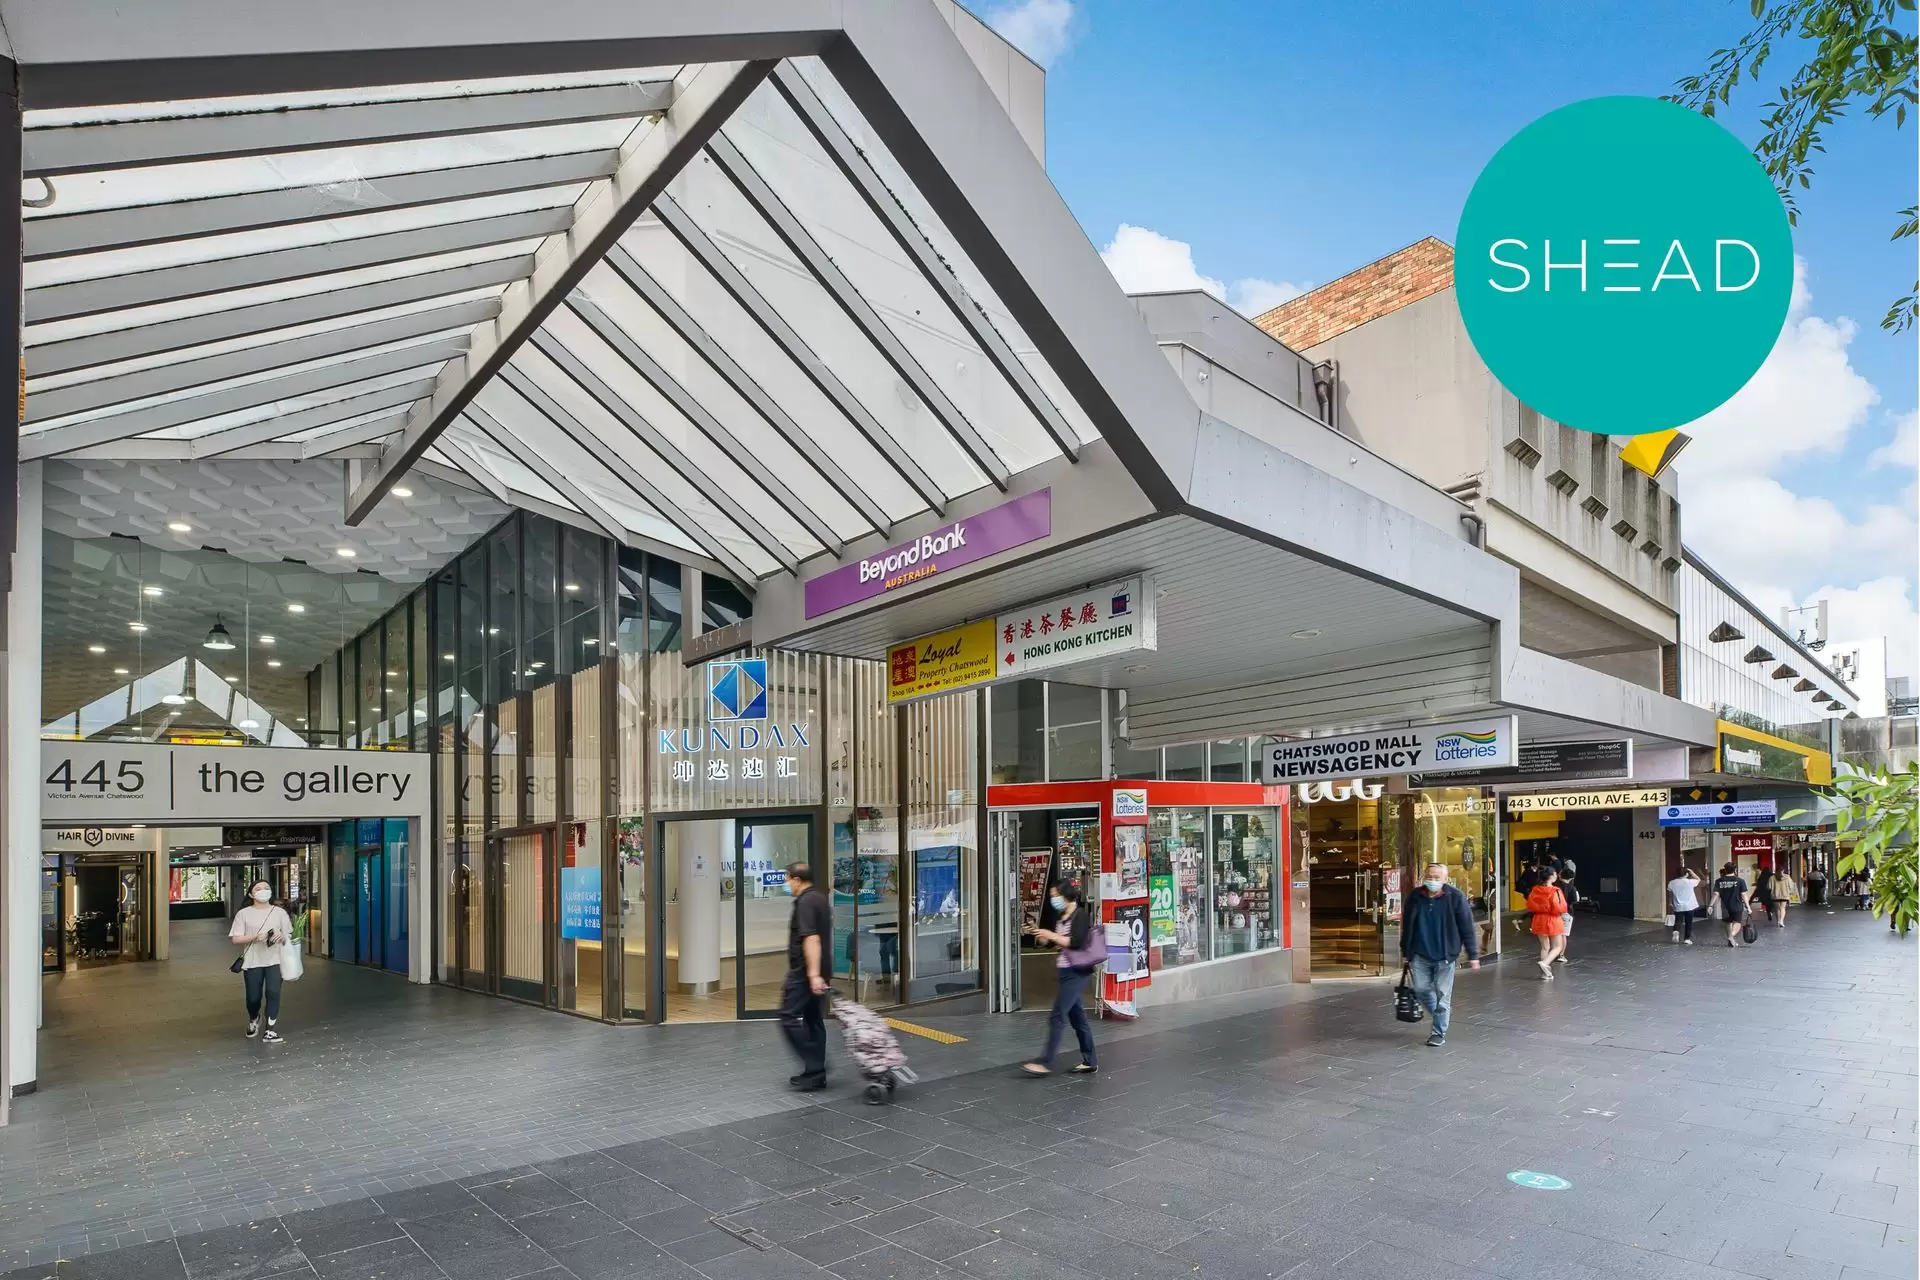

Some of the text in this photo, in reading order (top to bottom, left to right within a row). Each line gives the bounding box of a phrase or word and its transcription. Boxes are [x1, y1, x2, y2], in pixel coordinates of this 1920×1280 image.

[860, 523, 967, 584] Beyond Bank
[885, 563, 937, 588] AUSTRALIA
[1002, 601, 1098, 645] 香港茶餐廳
[919, 637, 963, 665] Loyal
[1023, 623, 1133, 660] HONG KONG KITCHEN
[918, 654, 989, 681] Property Chatswood
[953, 674, 963, 685] (02)
[964, 671, 977, 681] 9415
[892, 689, 905, 698] Shop
[659, 723, 811, 754] KUNDAX
[1272, 734, 1422, 761] CHATSWOOD MALL
[1437, 738, 1461, 749] NSW
[1272, 750, 1422, 778] NEWSAGENCY
[1435, 745, 1497, 763] Lotteries
[45, 759, 412, 802] 445 the gallery
[672, 755, 798, 782] 坤达速汇
[1116, 803, 1145, 815] Lotteries
[1117, 796, 1129, 804] NSW
[1509, 798, 1532, 808] 443
[1538, 796, 1601, 807] VICTORIA
[1605, 794, 1634, 804] AVE.
[1640, 791, 1667, 803] 443
[57, 831, 82, 841] HAIR
[105, 832, 135, 841] DIVINE
[1639, 831, 1655, 840] 443
[766, 873, 787, 882] OPEN
